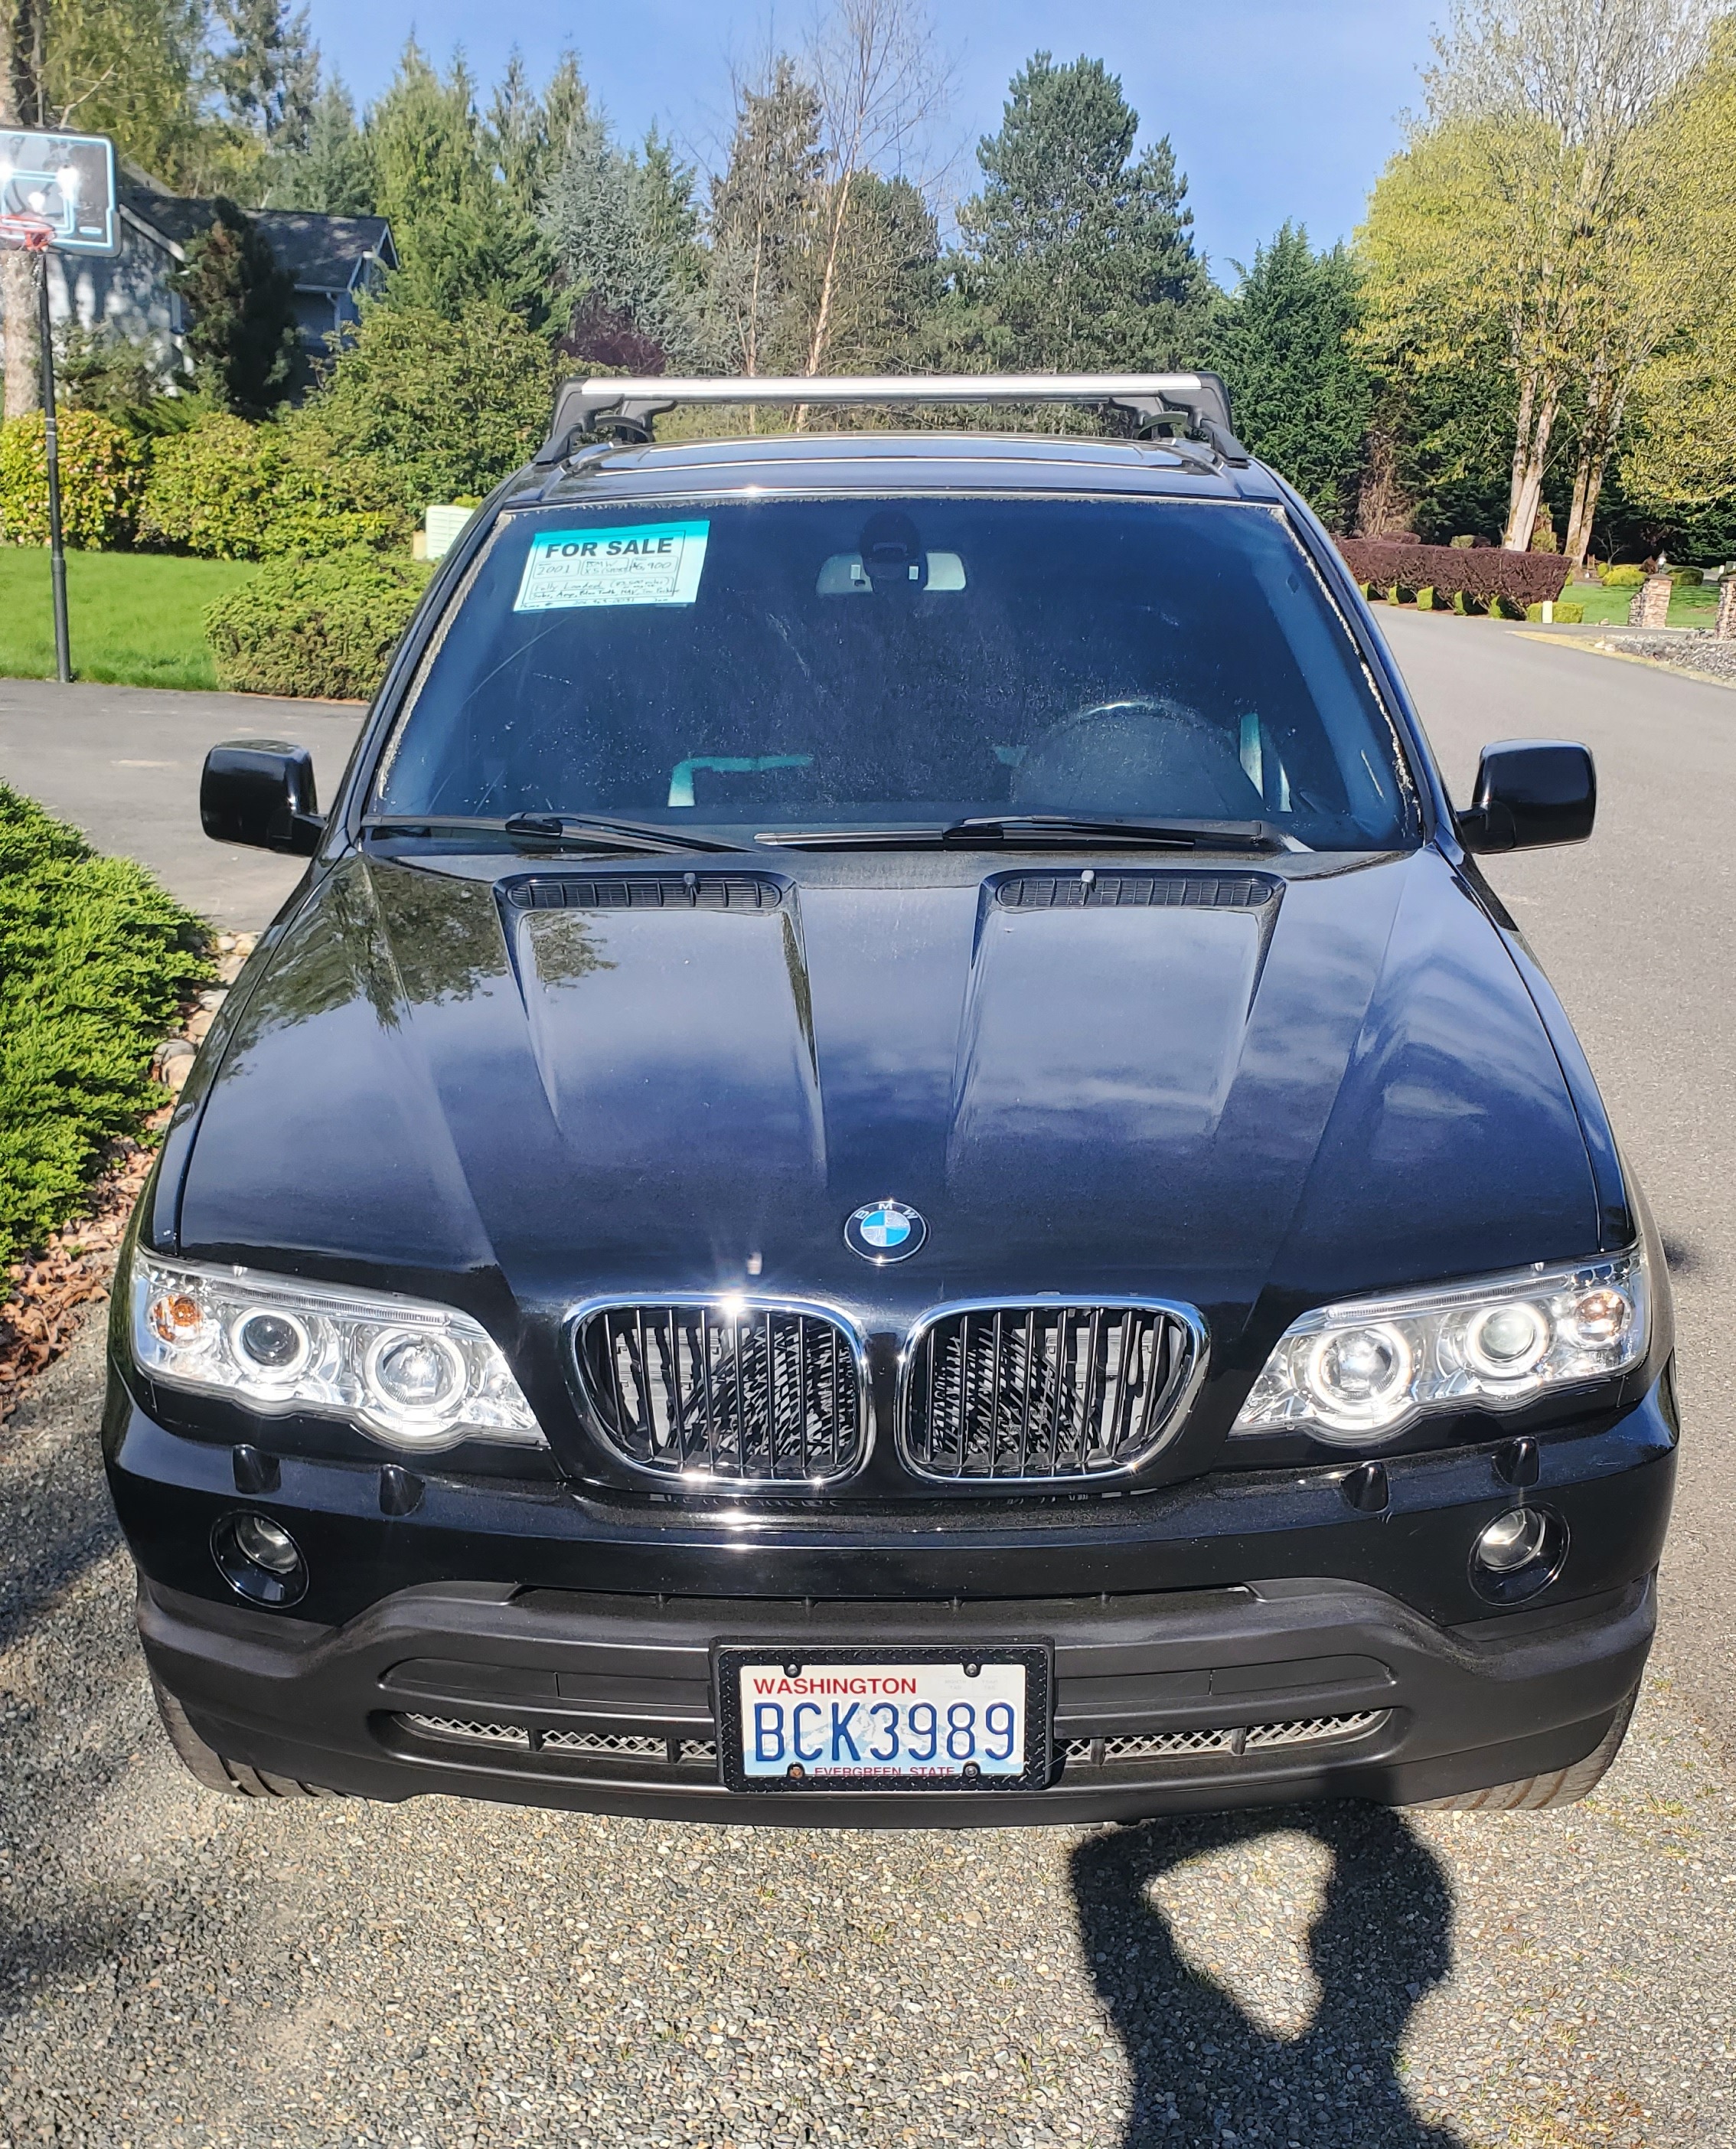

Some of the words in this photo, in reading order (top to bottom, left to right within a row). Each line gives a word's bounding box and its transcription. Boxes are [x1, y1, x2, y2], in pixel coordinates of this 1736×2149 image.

[545, 541, 598, 558] FOR
[606, 537, 674, 555] SALE
[537, 565, 570, 575] 2001
[853, 1203, 919, 1220] BMW
[753, 1678, 917, 1694] WASHINGTON
[754, 1702, 1016, 1762] BCK3989
[814, 1766, 902, 1776] EVERGREEN
[909, 1766, 955, 1776] STATE
